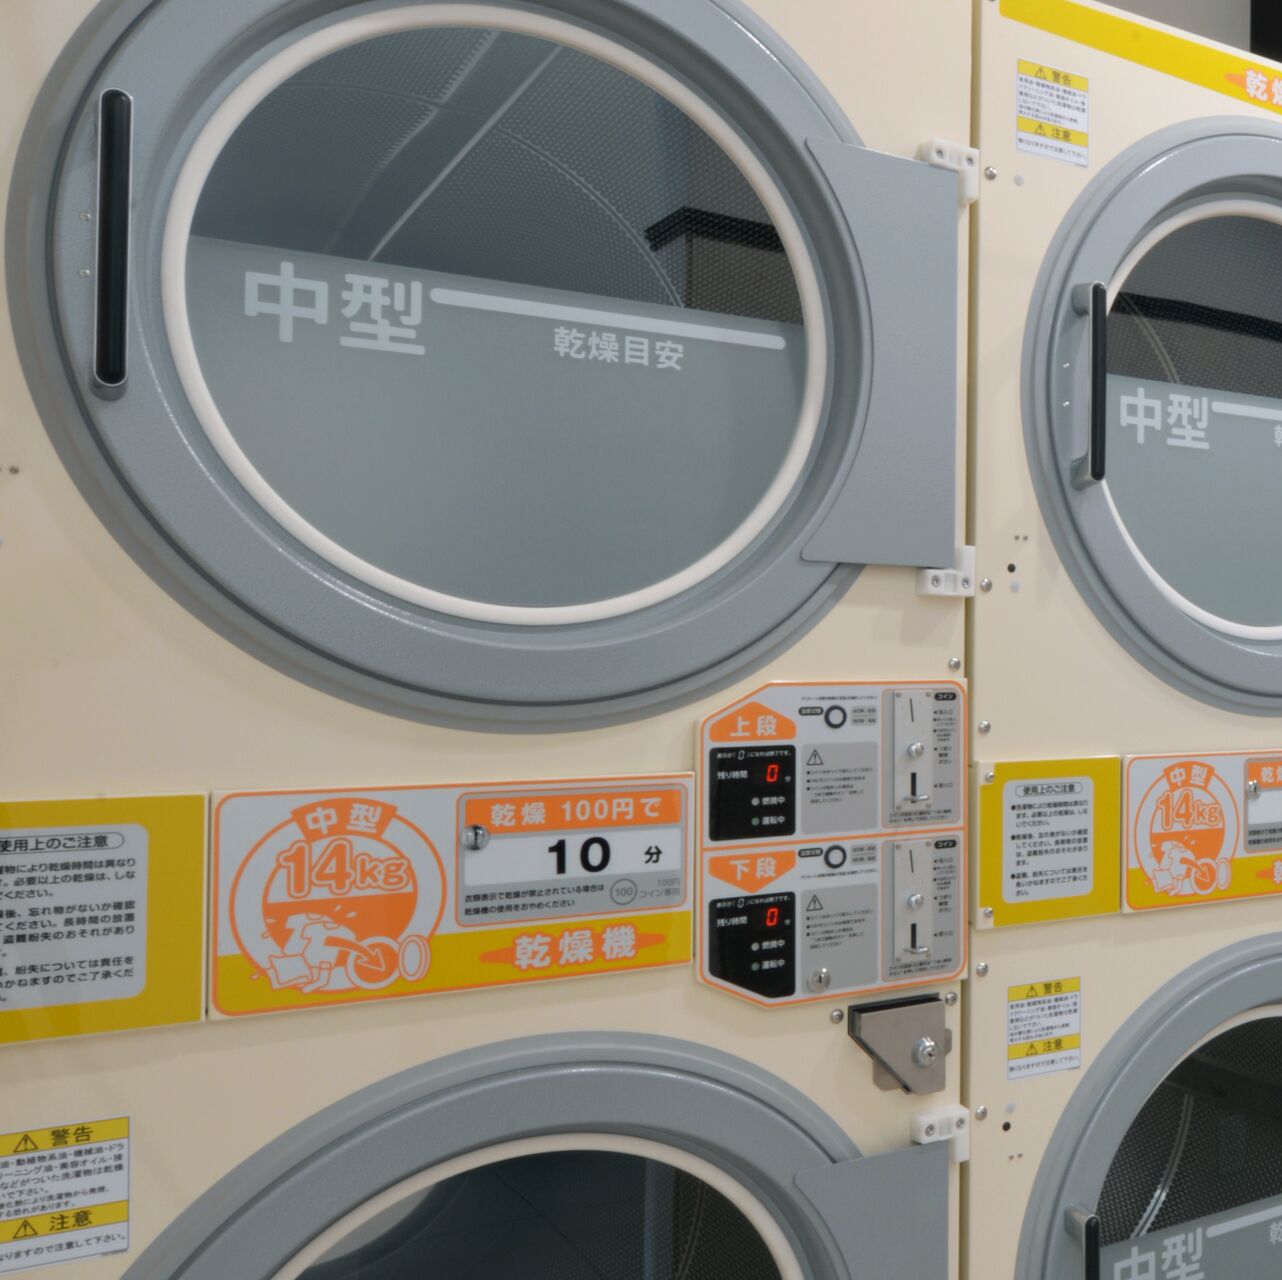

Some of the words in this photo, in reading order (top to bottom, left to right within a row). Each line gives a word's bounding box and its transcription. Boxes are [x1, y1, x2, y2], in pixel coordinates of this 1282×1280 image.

[244, 261, 426, 356] 中型
[552, 325, 684, 371] 乾燥目安
[1120, 387, 1210, 450] 中型
[729, 715, 777, 737] 上段
[766, 764, 779, 782] 0
[305, 803, 382, 834] 中型
[490, 802, 546, 825] 乾燥
[562, 797, 662, 821] 100円で
[1156, 789, 1220, 829] 14kg
[0, 835, 108, 852] 使用上のご注意
[548, 836, 611, 874] 10
[644, 845, 662, 864] 分
[277, 838, 410, 898] 14kg
[729, 856, 776, 880] 下段
[614, 886, 634, 897] 100
[766, 907, 779, 926] 0
[515, 924, 636, 969] 乾燥機
[51, 1126, 93, 1147] 警告
[50, 1210, 92, 1232] 注意
